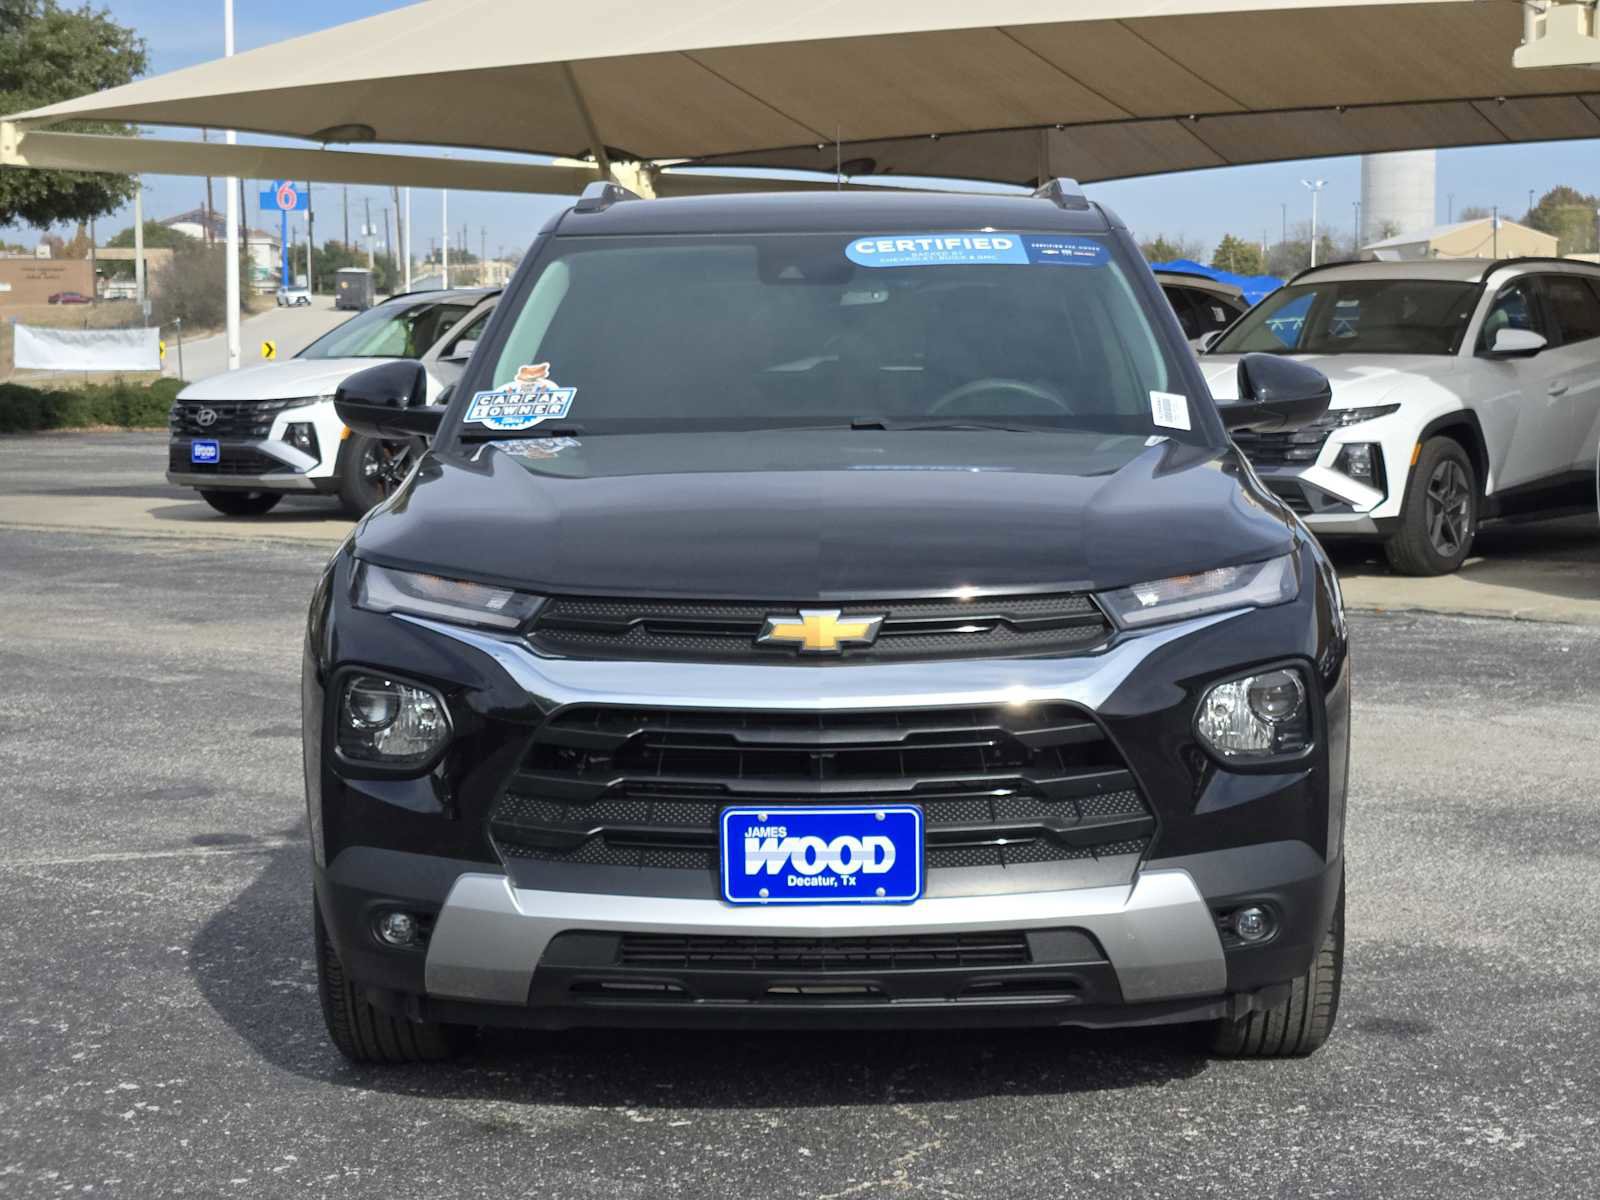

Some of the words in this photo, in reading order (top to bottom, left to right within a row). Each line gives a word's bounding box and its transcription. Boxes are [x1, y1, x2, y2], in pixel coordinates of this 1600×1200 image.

[276, 179, 297, 210] 6
[855, 237, 1013, 253] CERTIFIED
[479, 392, 566, 405] CARFAX
[489, 404, 562, 416] OWNER
[744, 826, 788, 838] JAMES
[744, 835, 897, 876] WOOD
[787, 875, 839, 888] Decatur,
[841, 875, 857, 887] Tx
